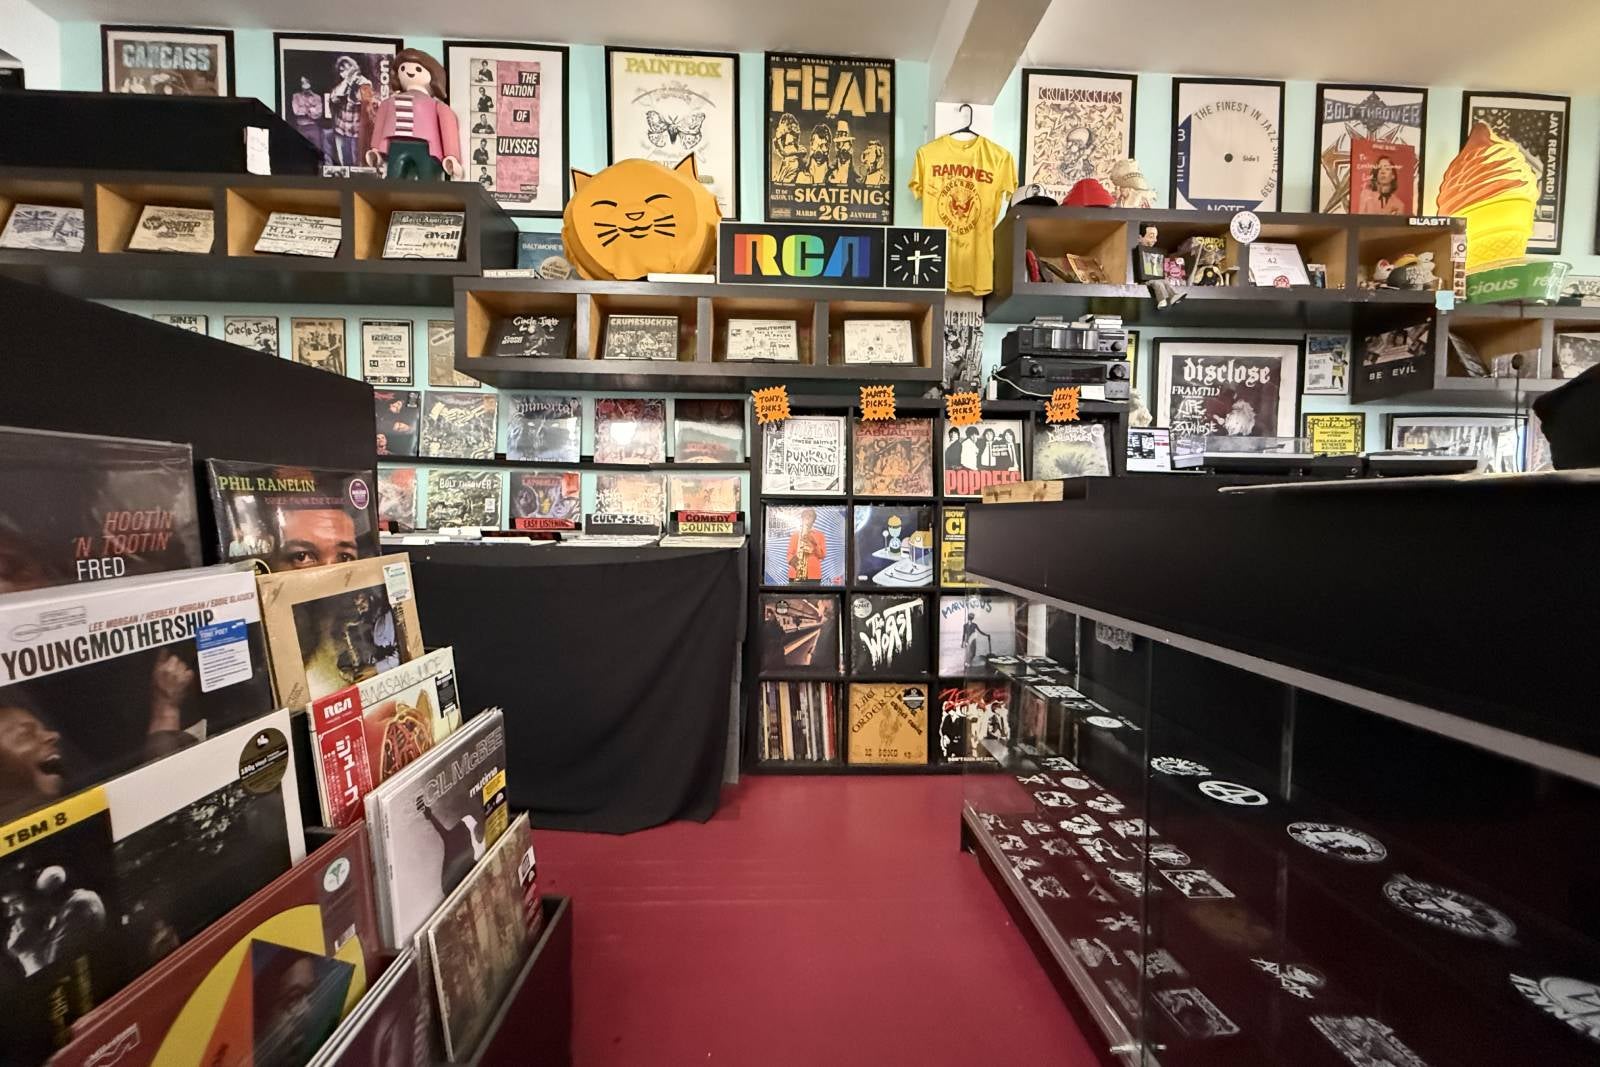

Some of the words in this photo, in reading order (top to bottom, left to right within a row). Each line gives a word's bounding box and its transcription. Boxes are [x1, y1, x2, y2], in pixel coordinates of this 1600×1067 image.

[624, 57, 722, 78] PAINTBOX
[521, 72, 537, 85] THE
[502, 84, 535, 97] NATION
[771, 65, 891, 117] FEAR
[516, 110, 528, 122] OF
[1194, 105, 1214, 121] THE
[1216, 101, 1248, 113] FINEST
[1251, 109, 1262, 121] IN
[1261, 120, 1277, 142] JAZZ
[1325, 101, 1354, 119] BOLT
[1360, 105, 1420, 125] THROWER
[1549, 113, 1559, 136] JAY
[498, 138, 539, 155] ULYSSES
[932, 164, 994, 184] RAMONES
[1545, 140, 1557, 194] REATARD
[819, 205, 849, 221] 26
[850, 210, 877, 219] JANVIER
[733, 233, 871, 277] RCA
[1183, 358, 1271, 387] disclose
[1369, 371, 1383, 380] BE
[1392, 365, 1417, 376] EVIL
[865, 399, 888, 408] PICKS
[218, 476, 254, 491] PHIL
[257, 477, 316, 492] RANELIN
[439, 478, 456, 489] BOLT
[106, 507, 176, 532] HOOTIN'
[681, 523, 731, 532] COUNTRY
[685, 514, 730, 522] COMEDY
[76, 557, 125, 581] FRED
[88, 621, 105, 632] LEE
[106, 616, 138, 630] MORGAN
[143, 607, 178, 621] HERBERT
[178, 601, 206, 614] MORGAN
[323, 697, 353, 719] RCA
[852, 699, 886, 733] ORDER
[240, 764, 255, 775] 180g
[469, 766, 498, 798] mutima
[4, 820, 48, 847] TBM
[53, 812, 67, 826] 8
